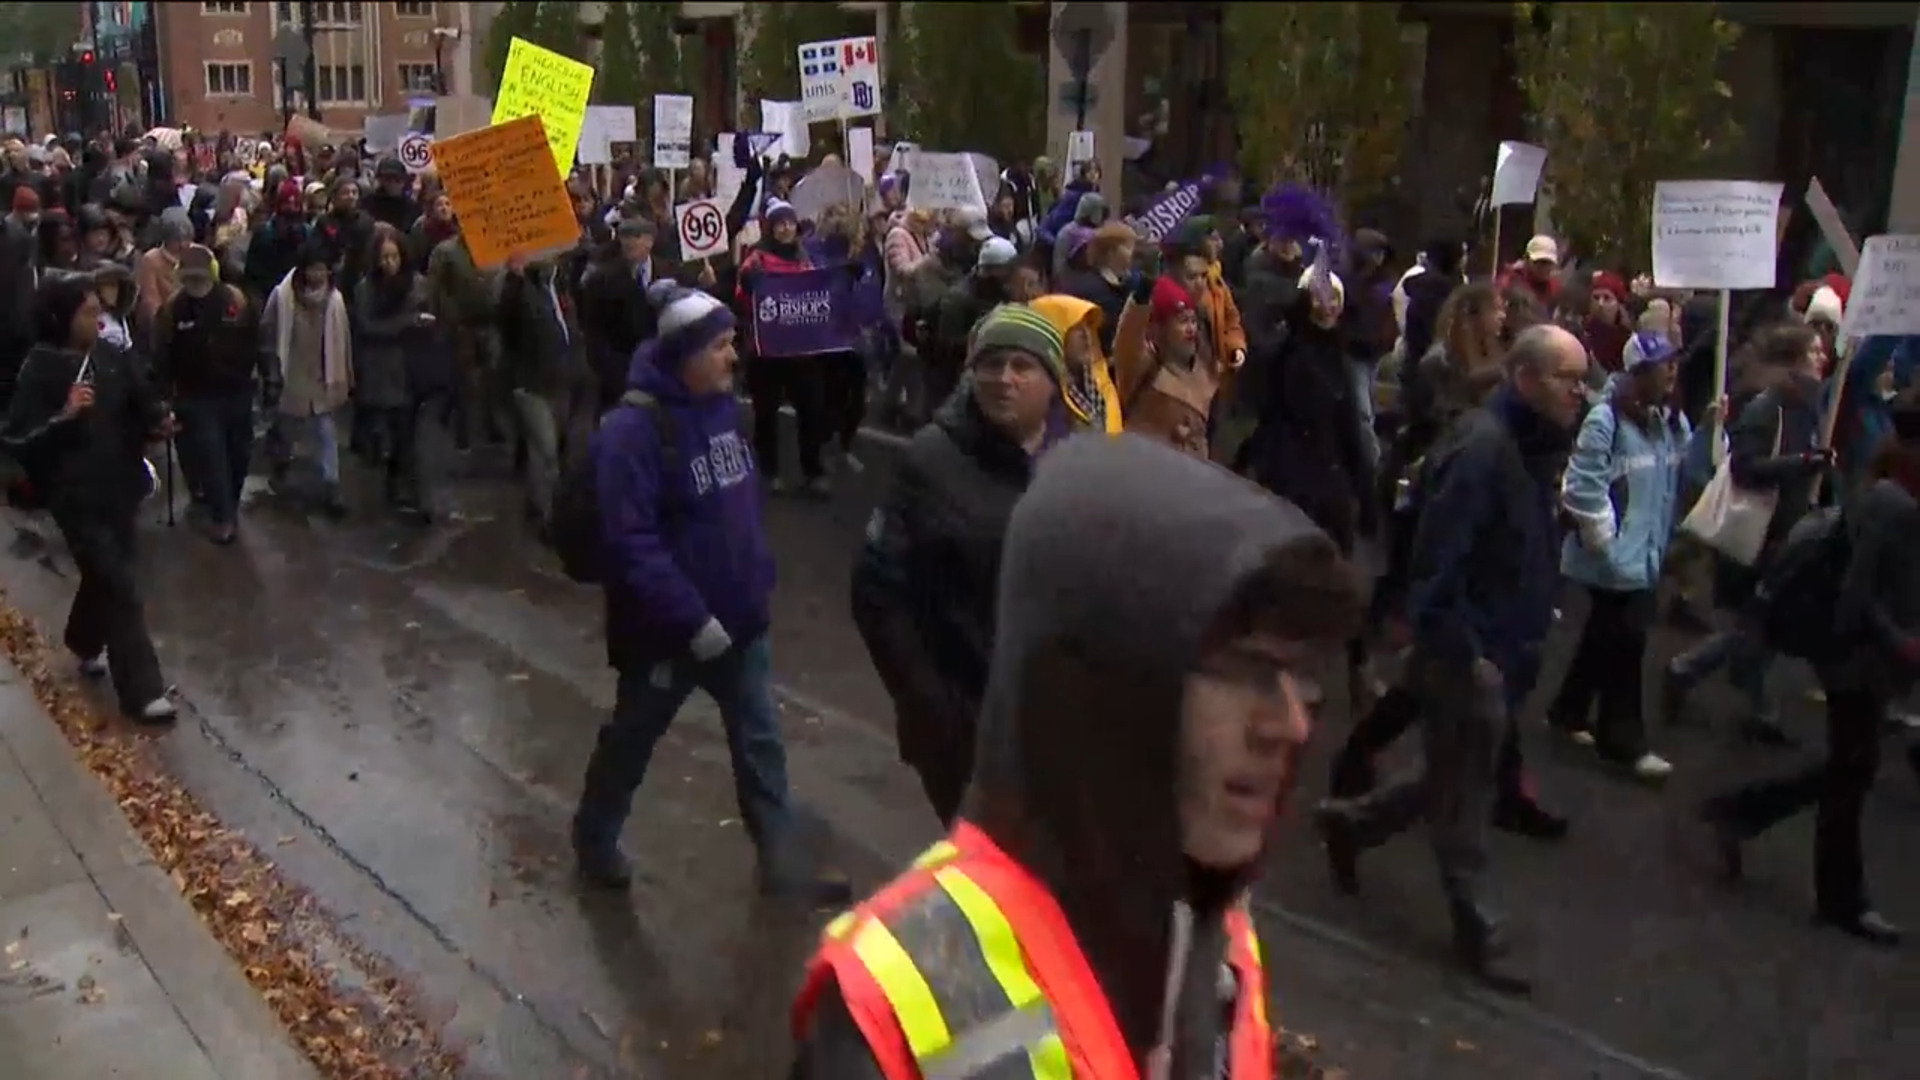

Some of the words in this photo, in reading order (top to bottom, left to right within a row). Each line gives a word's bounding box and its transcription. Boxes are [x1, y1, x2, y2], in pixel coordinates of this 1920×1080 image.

[519, 64, 581, 99] ENGLISH
[405, 143, 430, 163] 96
[686, 211, 718, 242] 96
